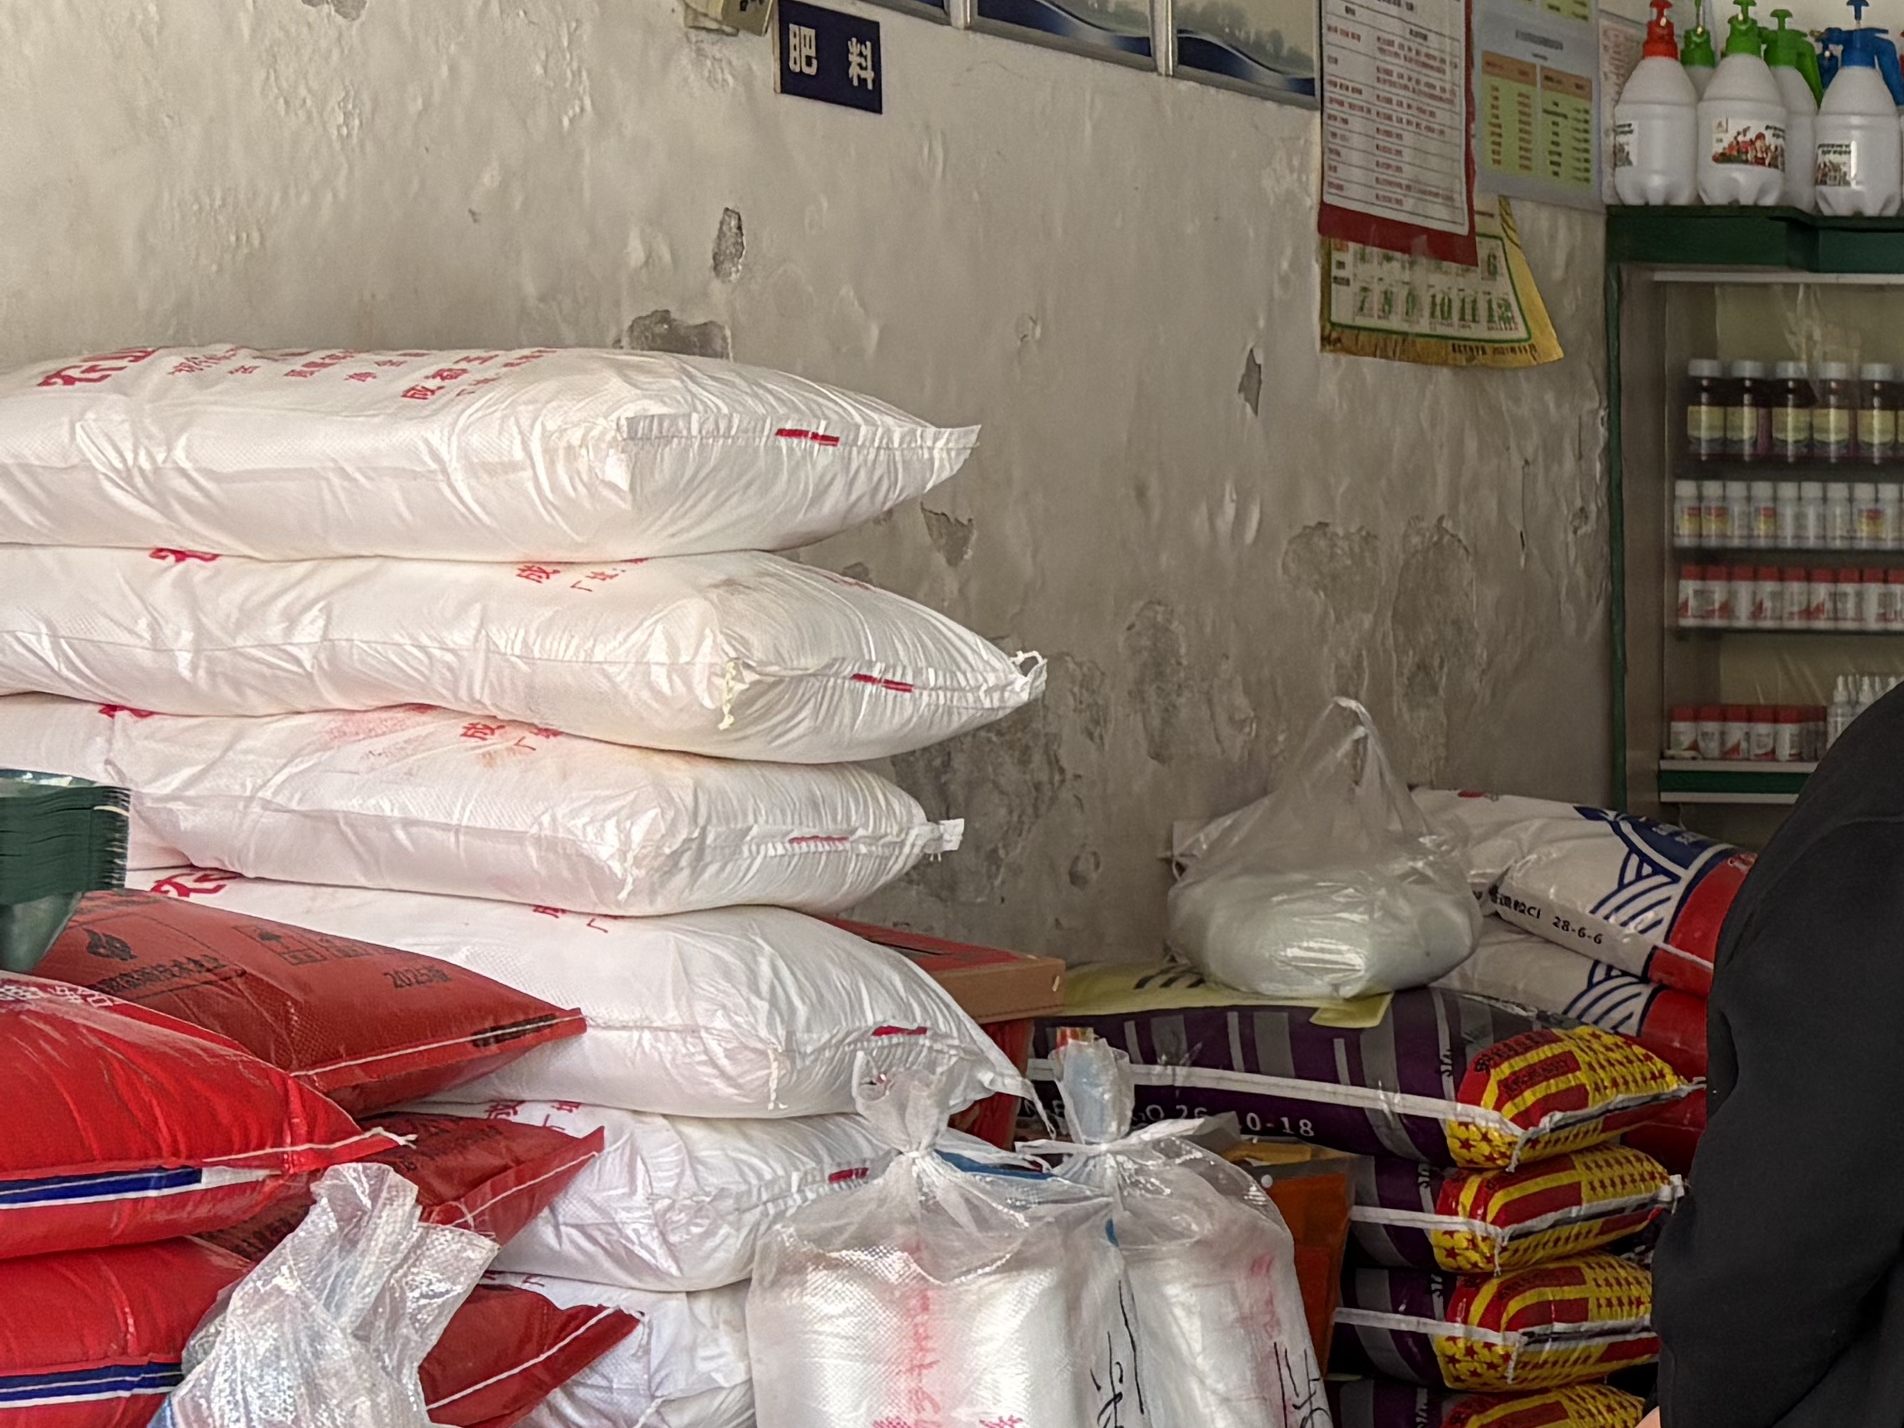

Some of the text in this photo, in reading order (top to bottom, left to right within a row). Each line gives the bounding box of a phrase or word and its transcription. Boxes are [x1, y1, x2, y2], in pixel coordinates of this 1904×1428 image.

[788, 23, 876, 91] 肥料
[1428, 293, 1453, 323] 10
[1457, 294, 1481, 324] 11
